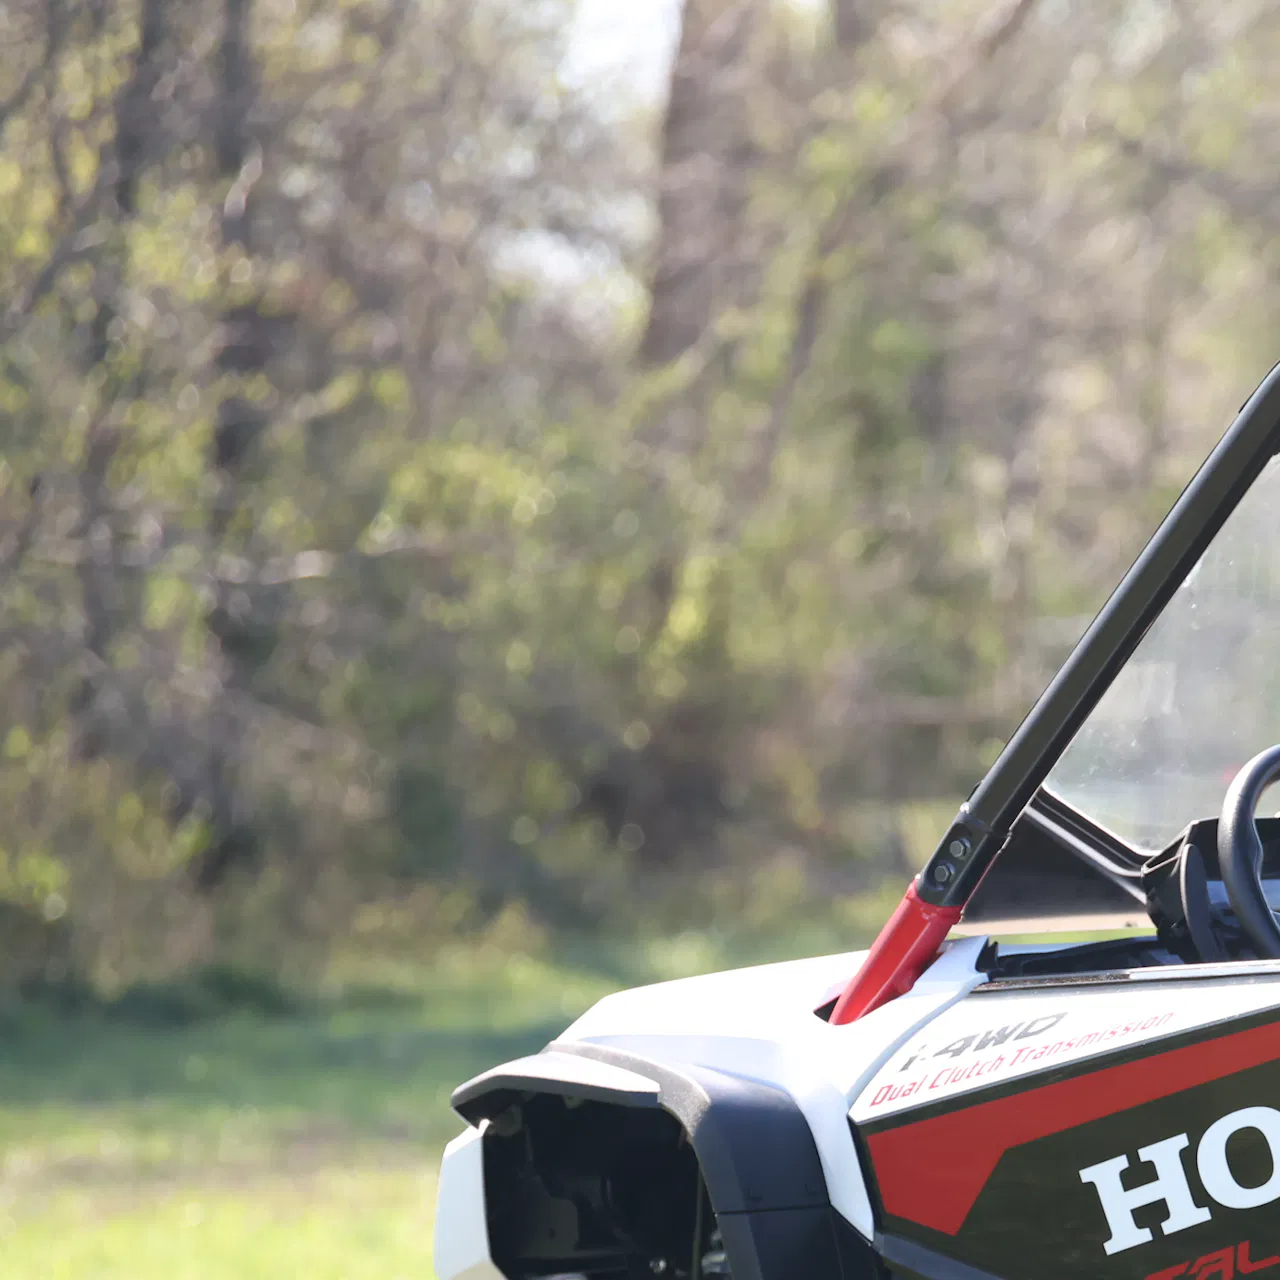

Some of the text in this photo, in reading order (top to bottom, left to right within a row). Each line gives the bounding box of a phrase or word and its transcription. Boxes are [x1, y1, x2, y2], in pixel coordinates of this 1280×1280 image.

[869, 1011, 1175, 1107] Dual Clutch Transmission
